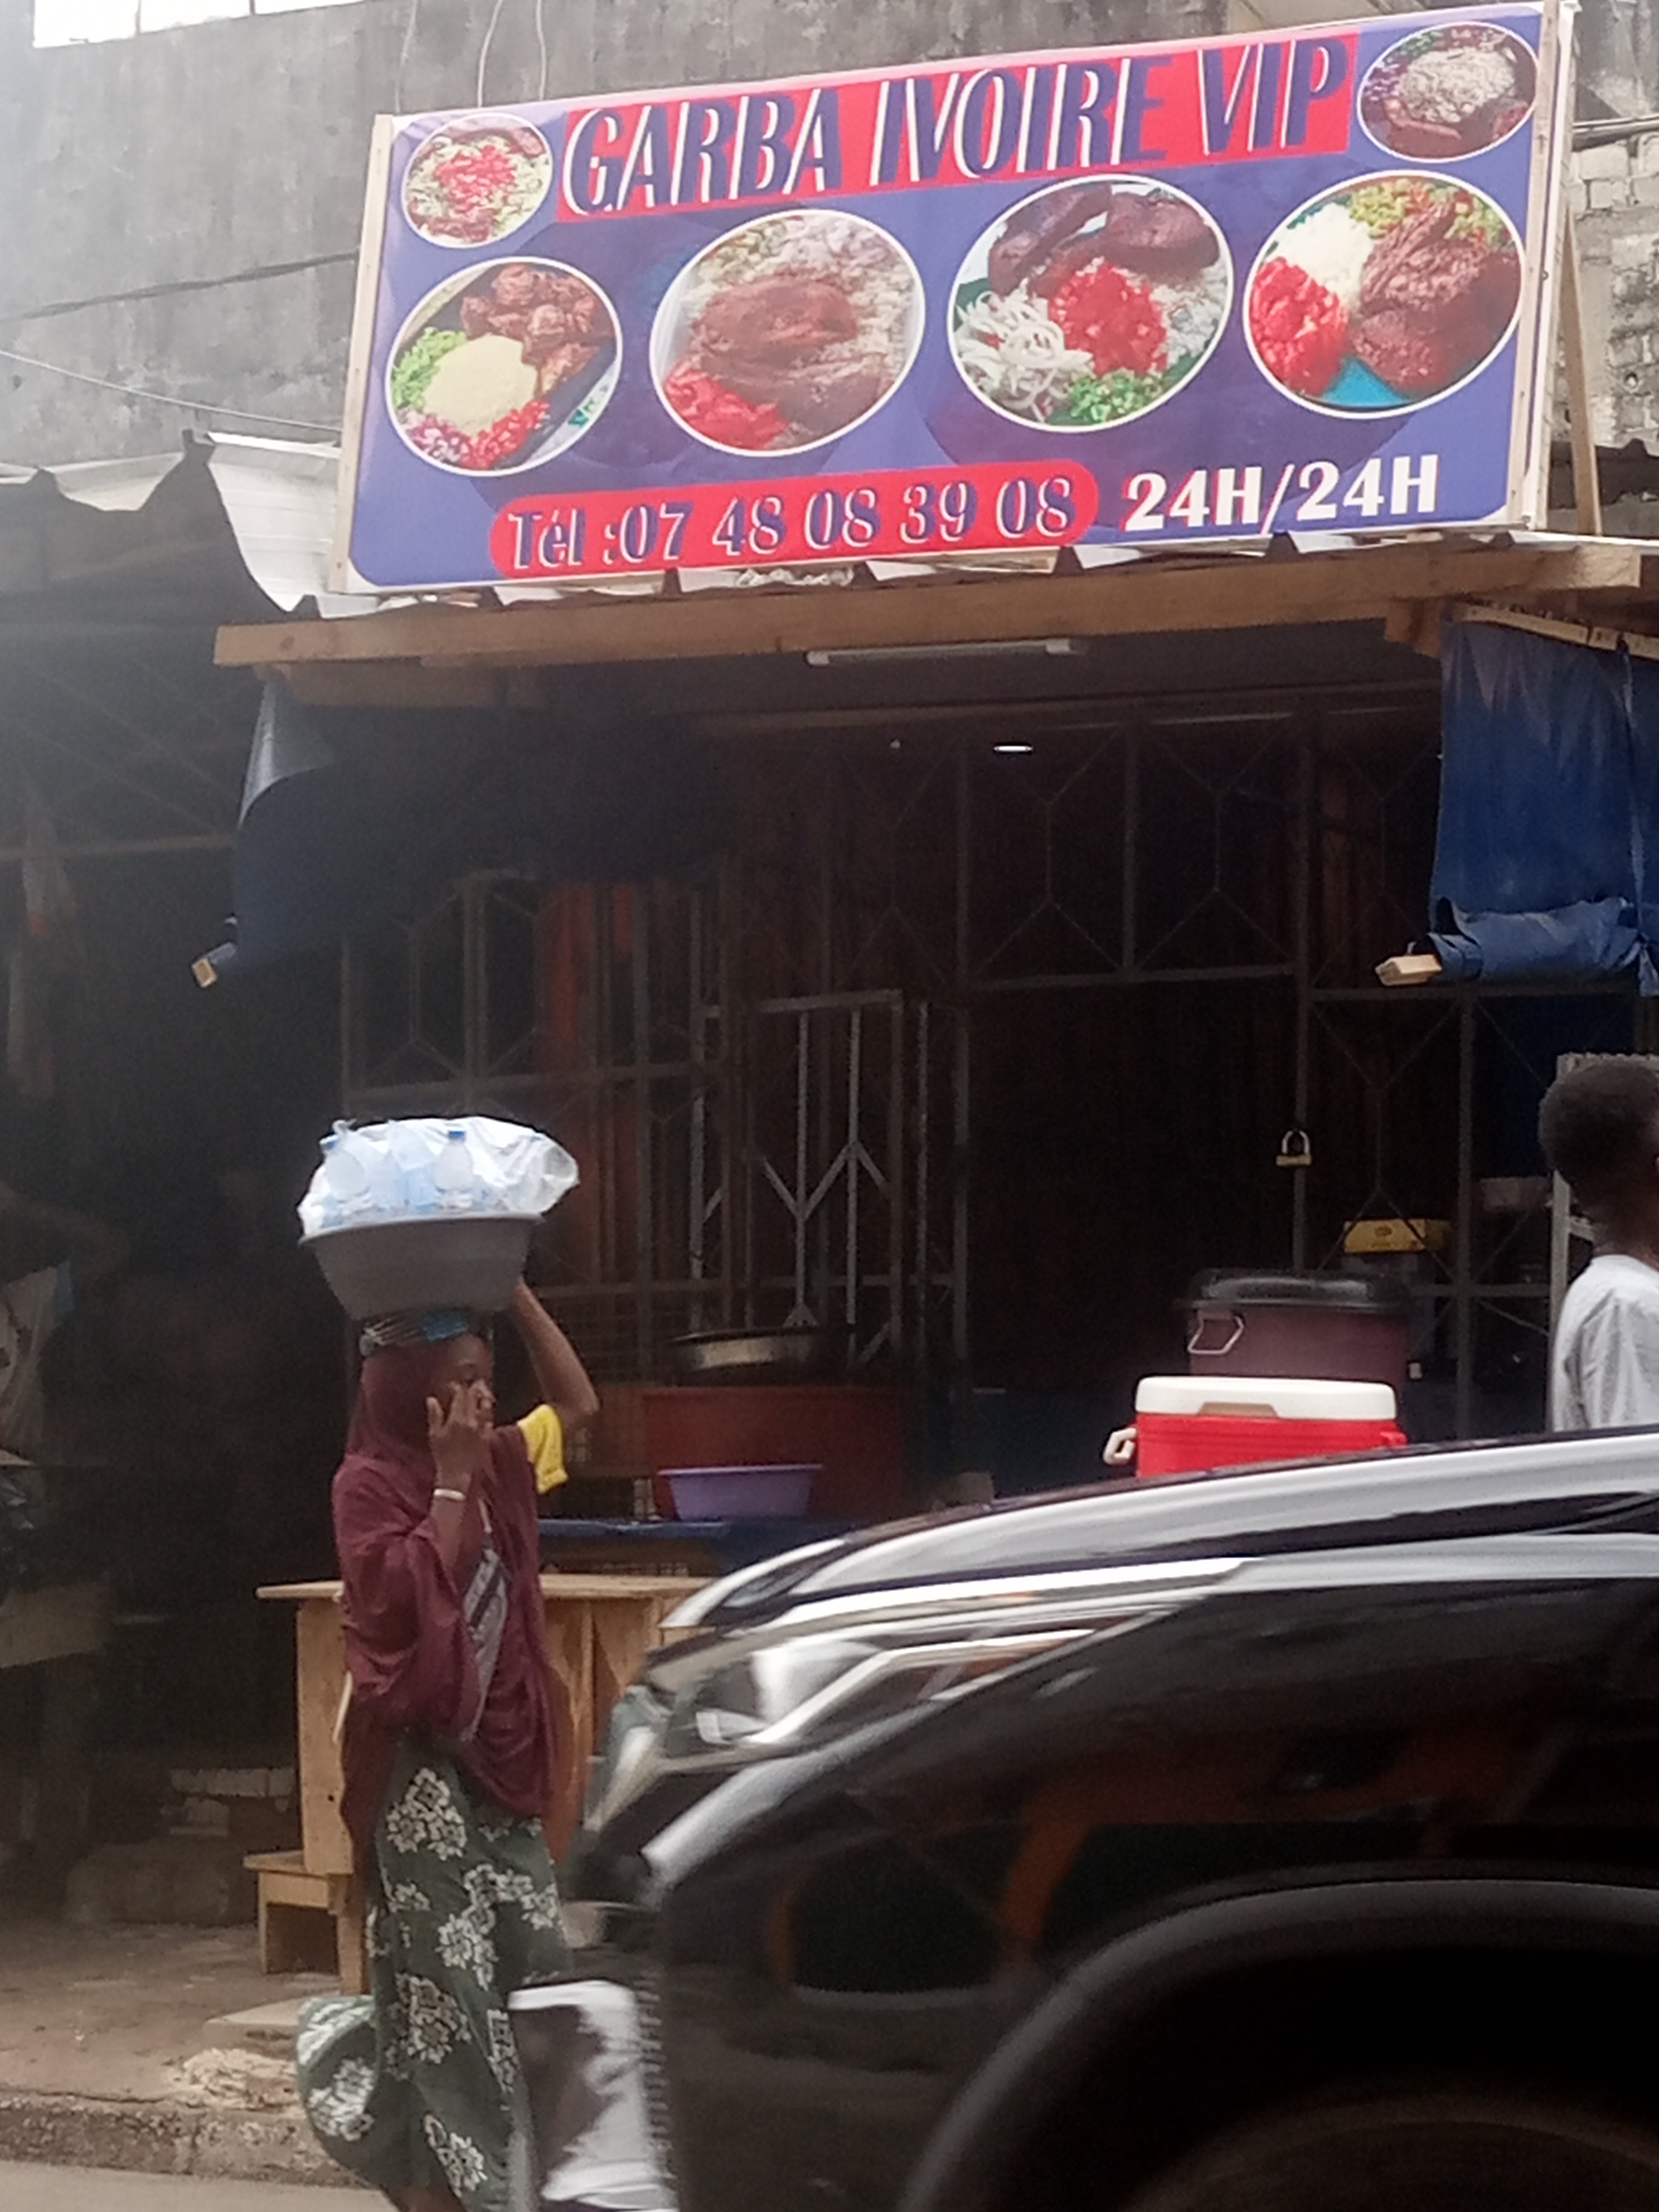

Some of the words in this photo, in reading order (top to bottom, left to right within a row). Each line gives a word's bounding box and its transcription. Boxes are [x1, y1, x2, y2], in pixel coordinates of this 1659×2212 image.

[562, 88, 843, 216] GARBA
[870, 54, 1173, 185] IVOIRE
[1197, 37, 1348, 156] VIP
[508, 508, 586, 569] Tél
[712, 495, 786, 556] 48
[804, 488, 881, 551] 08
[899, 481, 977, 544] 39
[996, 476, 1076, 538] 08
[1123, 454, 1439, 534] 24H/24H
